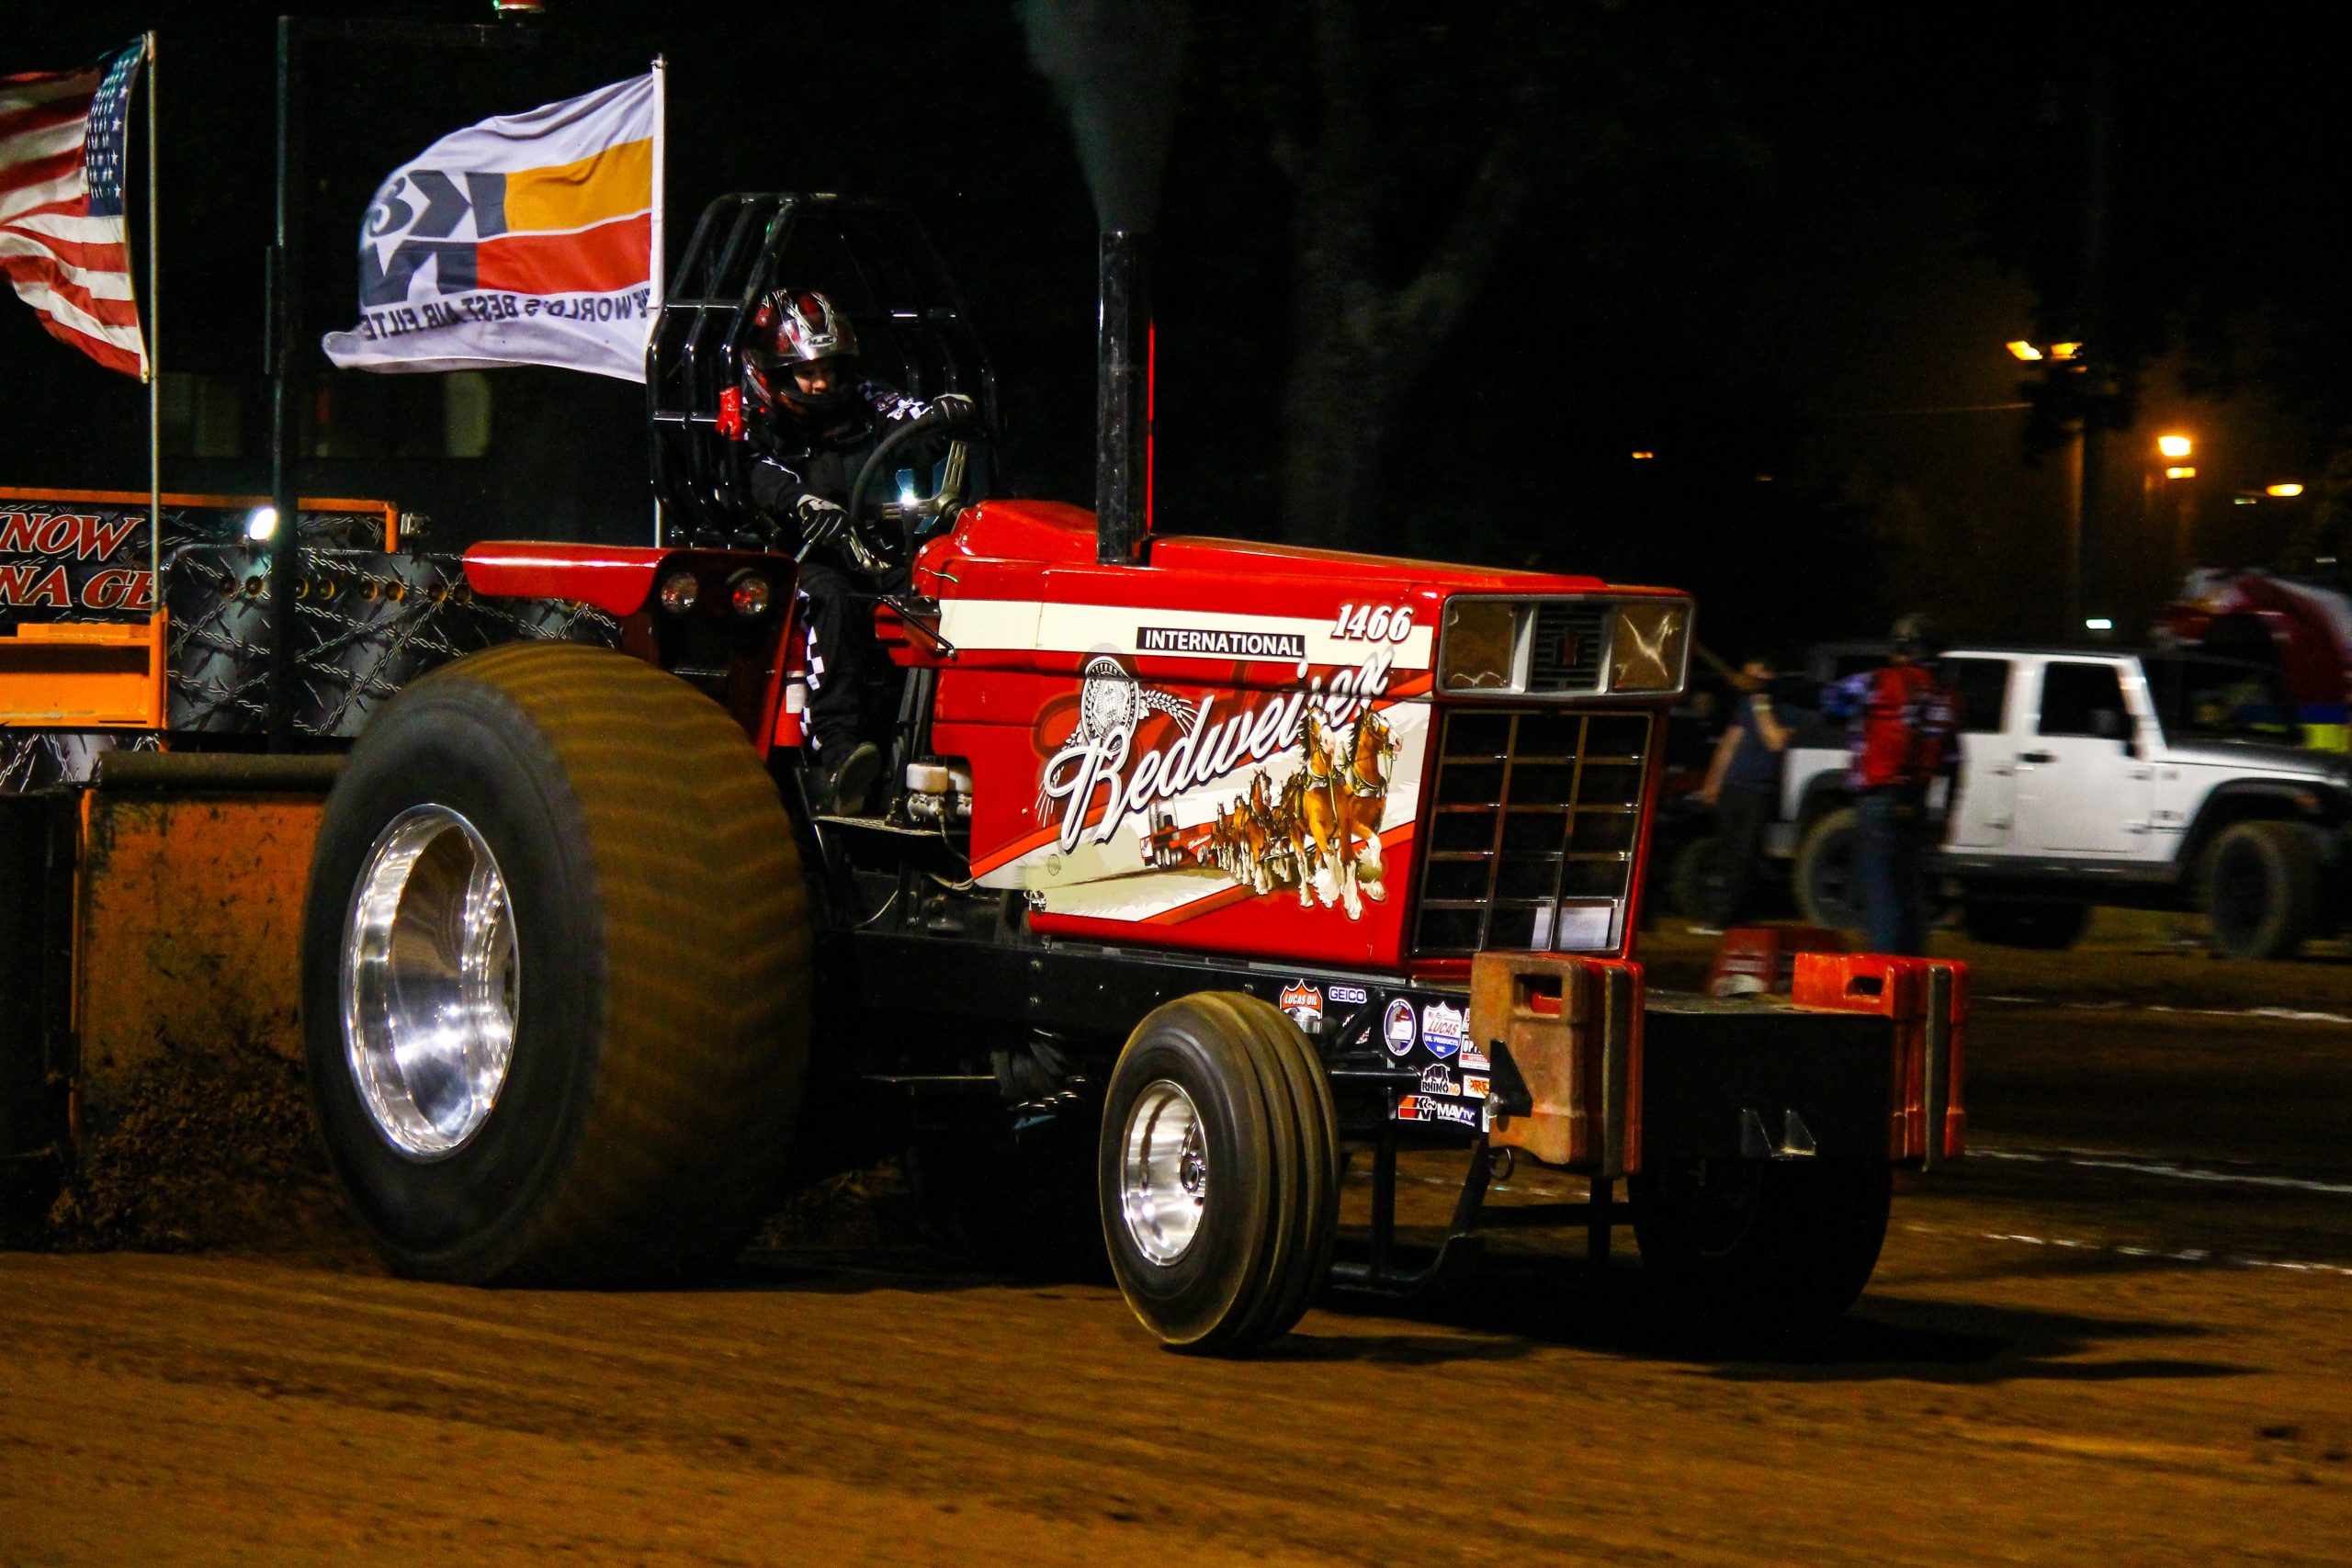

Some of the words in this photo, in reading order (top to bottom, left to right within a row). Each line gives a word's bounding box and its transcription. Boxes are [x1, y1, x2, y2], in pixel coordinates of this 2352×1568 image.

[1330, 604, 1415, 643] 1466
[1145, 628, 1304, 657] INTERNATIONAL
[1284, 994, 1306, 1006] LUCAS
[1306, 996, 1317, 1006] OIL
[1329, 987, 1365, 1002] GEICO
[1427, 1021, 1459, 1035] LUCAS
